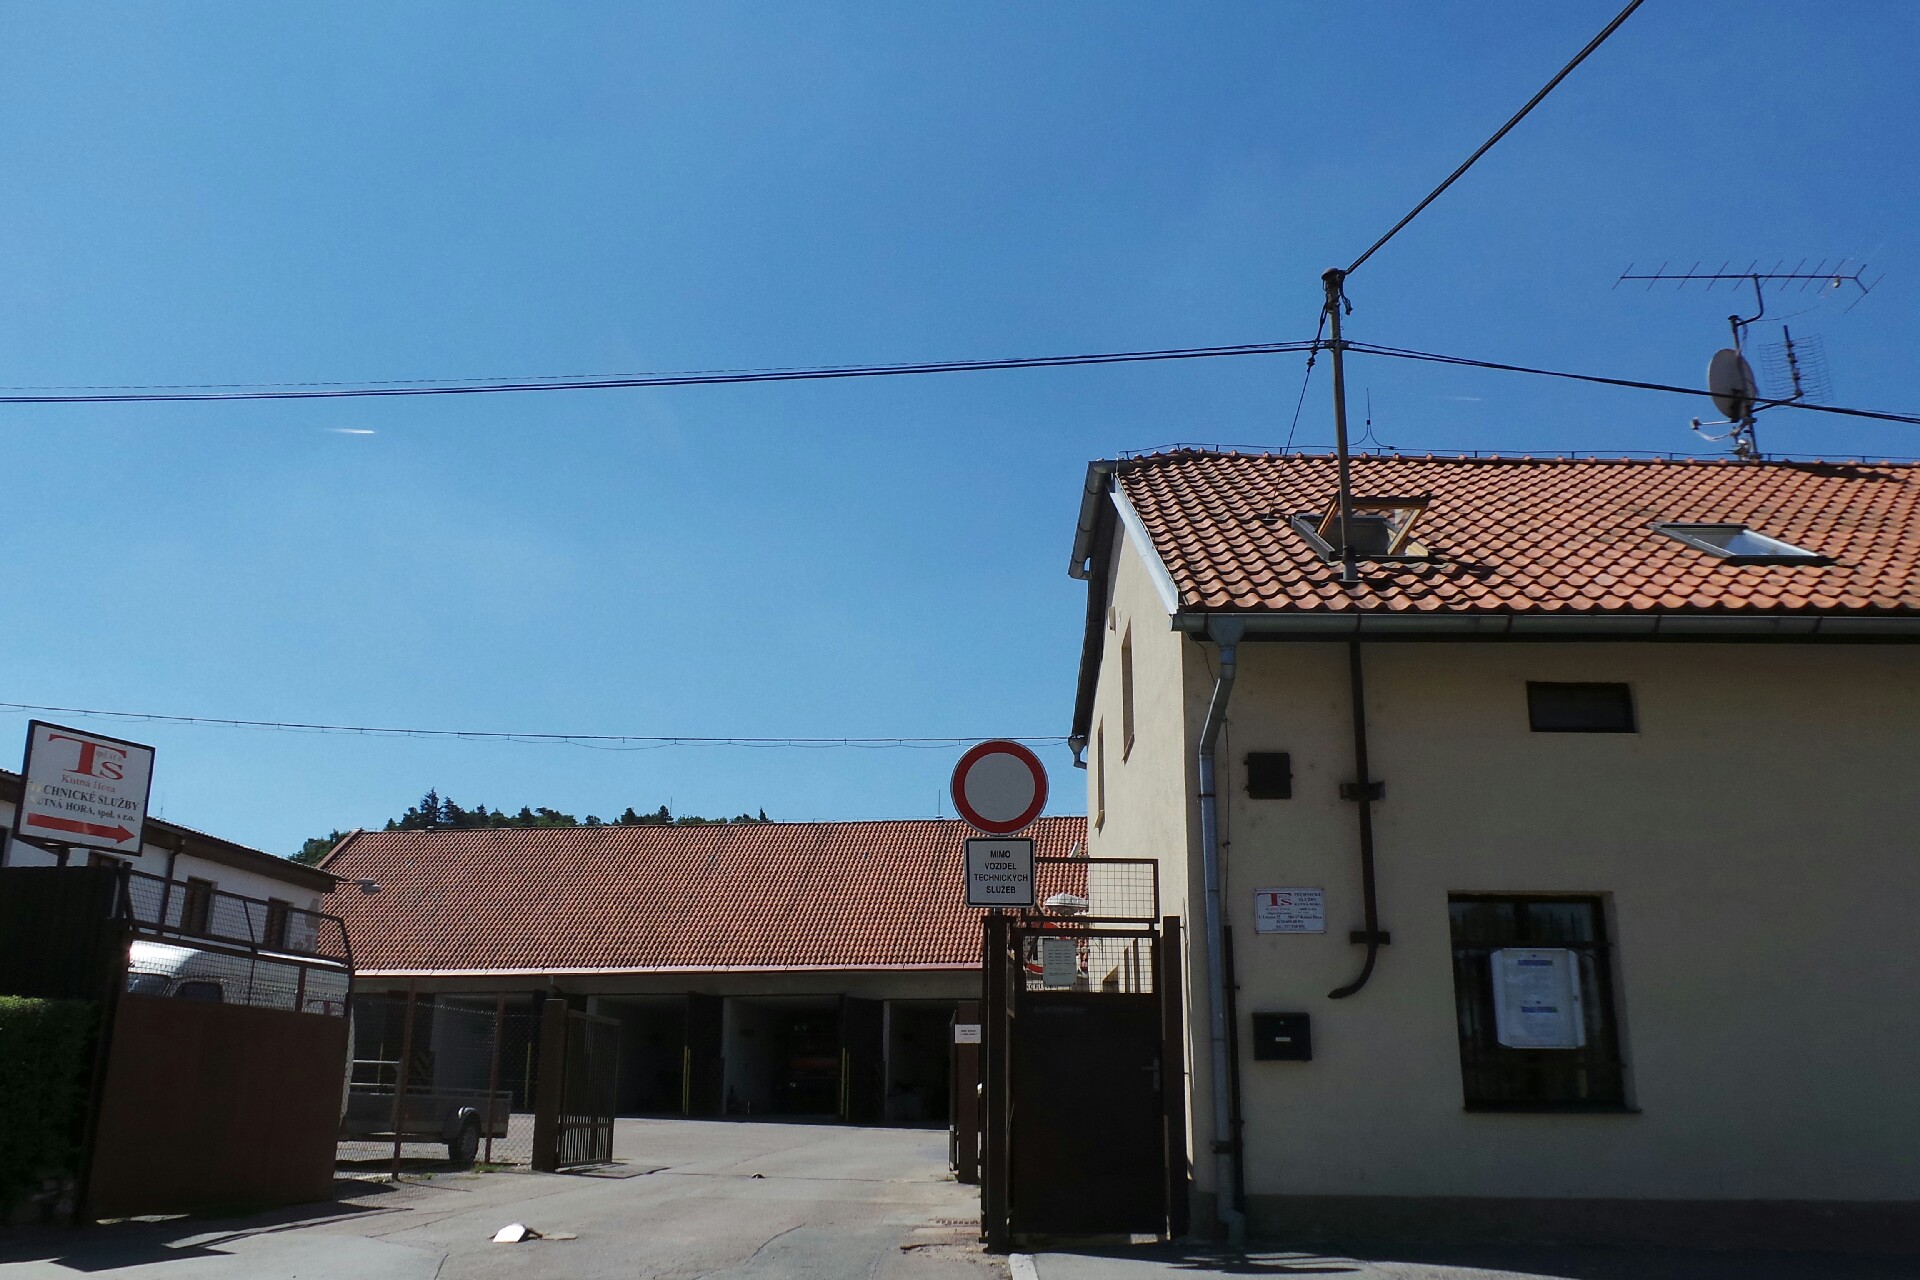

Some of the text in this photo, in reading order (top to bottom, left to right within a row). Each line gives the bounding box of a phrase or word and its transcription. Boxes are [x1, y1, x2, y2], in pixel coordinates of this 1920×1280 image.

[97, 795, 140, 811] SLUŽBY
[990, 850, 1011, 858] MIMO
[984, 862, 1017, 870] VOZIDEL
